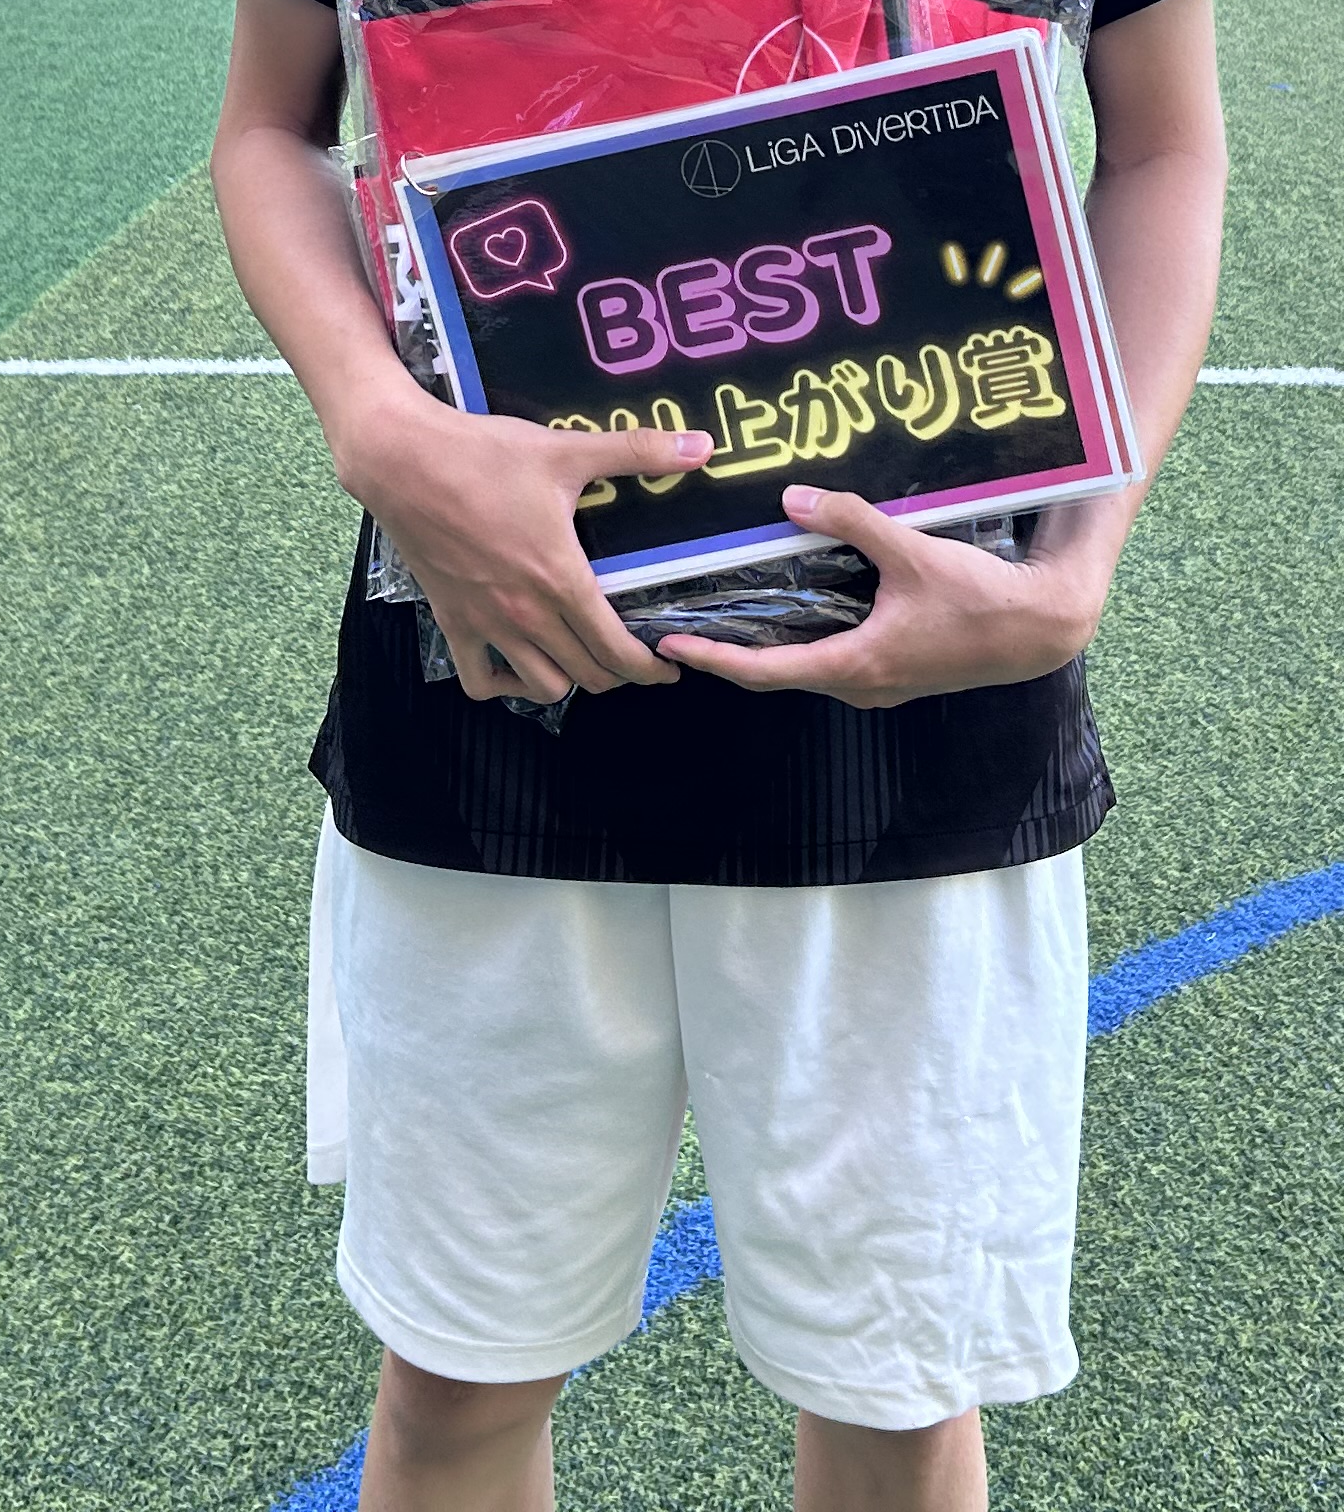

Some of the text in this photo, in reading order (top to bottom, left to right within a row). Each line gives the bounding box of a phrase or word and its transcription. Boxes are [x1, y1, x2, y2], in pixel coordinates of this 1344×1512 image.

[576, 224, 892, 375] BEST
[548, 325, 1066, 509] り上がり賞
